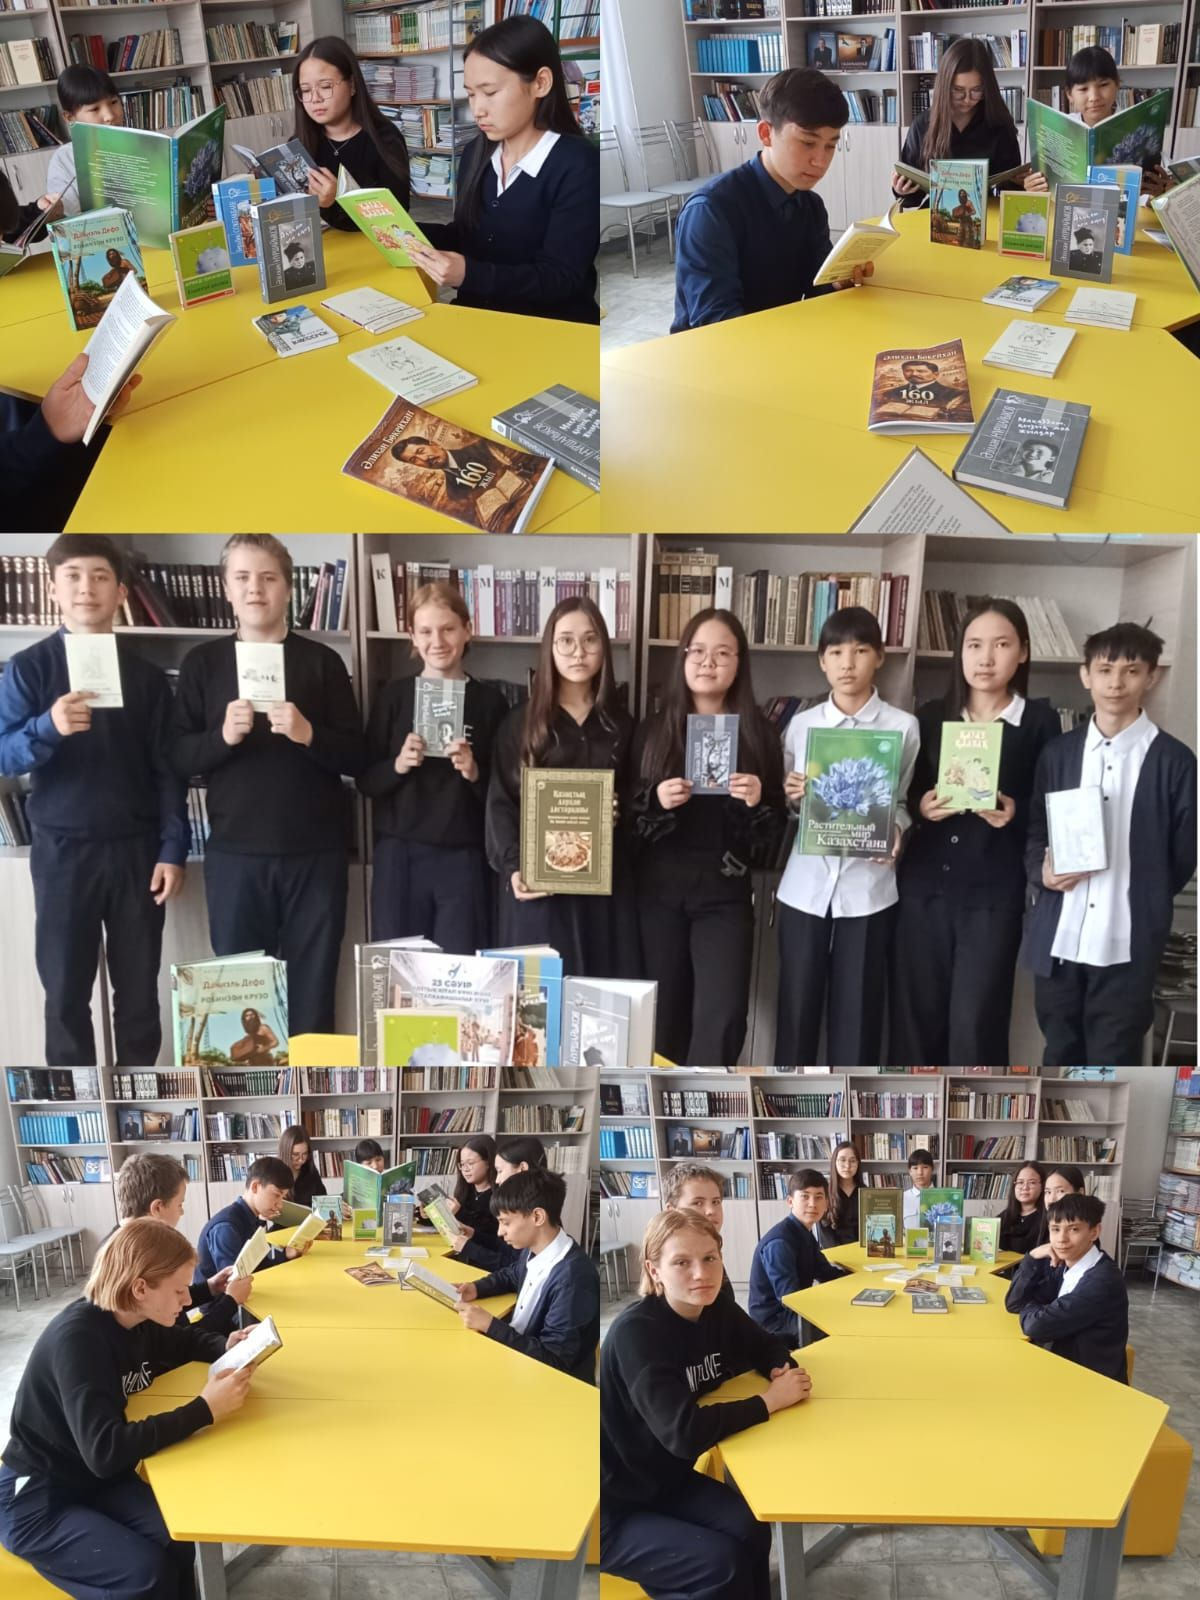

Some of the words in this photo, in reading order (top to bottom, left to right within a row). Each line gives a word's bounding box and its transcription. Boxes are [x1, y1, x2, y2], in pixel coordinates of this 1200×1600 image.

[900, 389, 935, 401] 160
[361, 441, 390, 470] Әлихан
[383, 409, 415, 444] Бөкейхан
[456, 462, 487, 489] 160
[376, 568, 386, 580] К
[480, 577, 491, 588] М
[542, 576, 555, 588] Ж
[719, 576, 729, 588] М
[808, 819, 876, 832] Растительный
[817, 833, 887, 849] Казахстана
[851, 831, 871, 841] мир
[241, 978, 265, 988] Дефо
